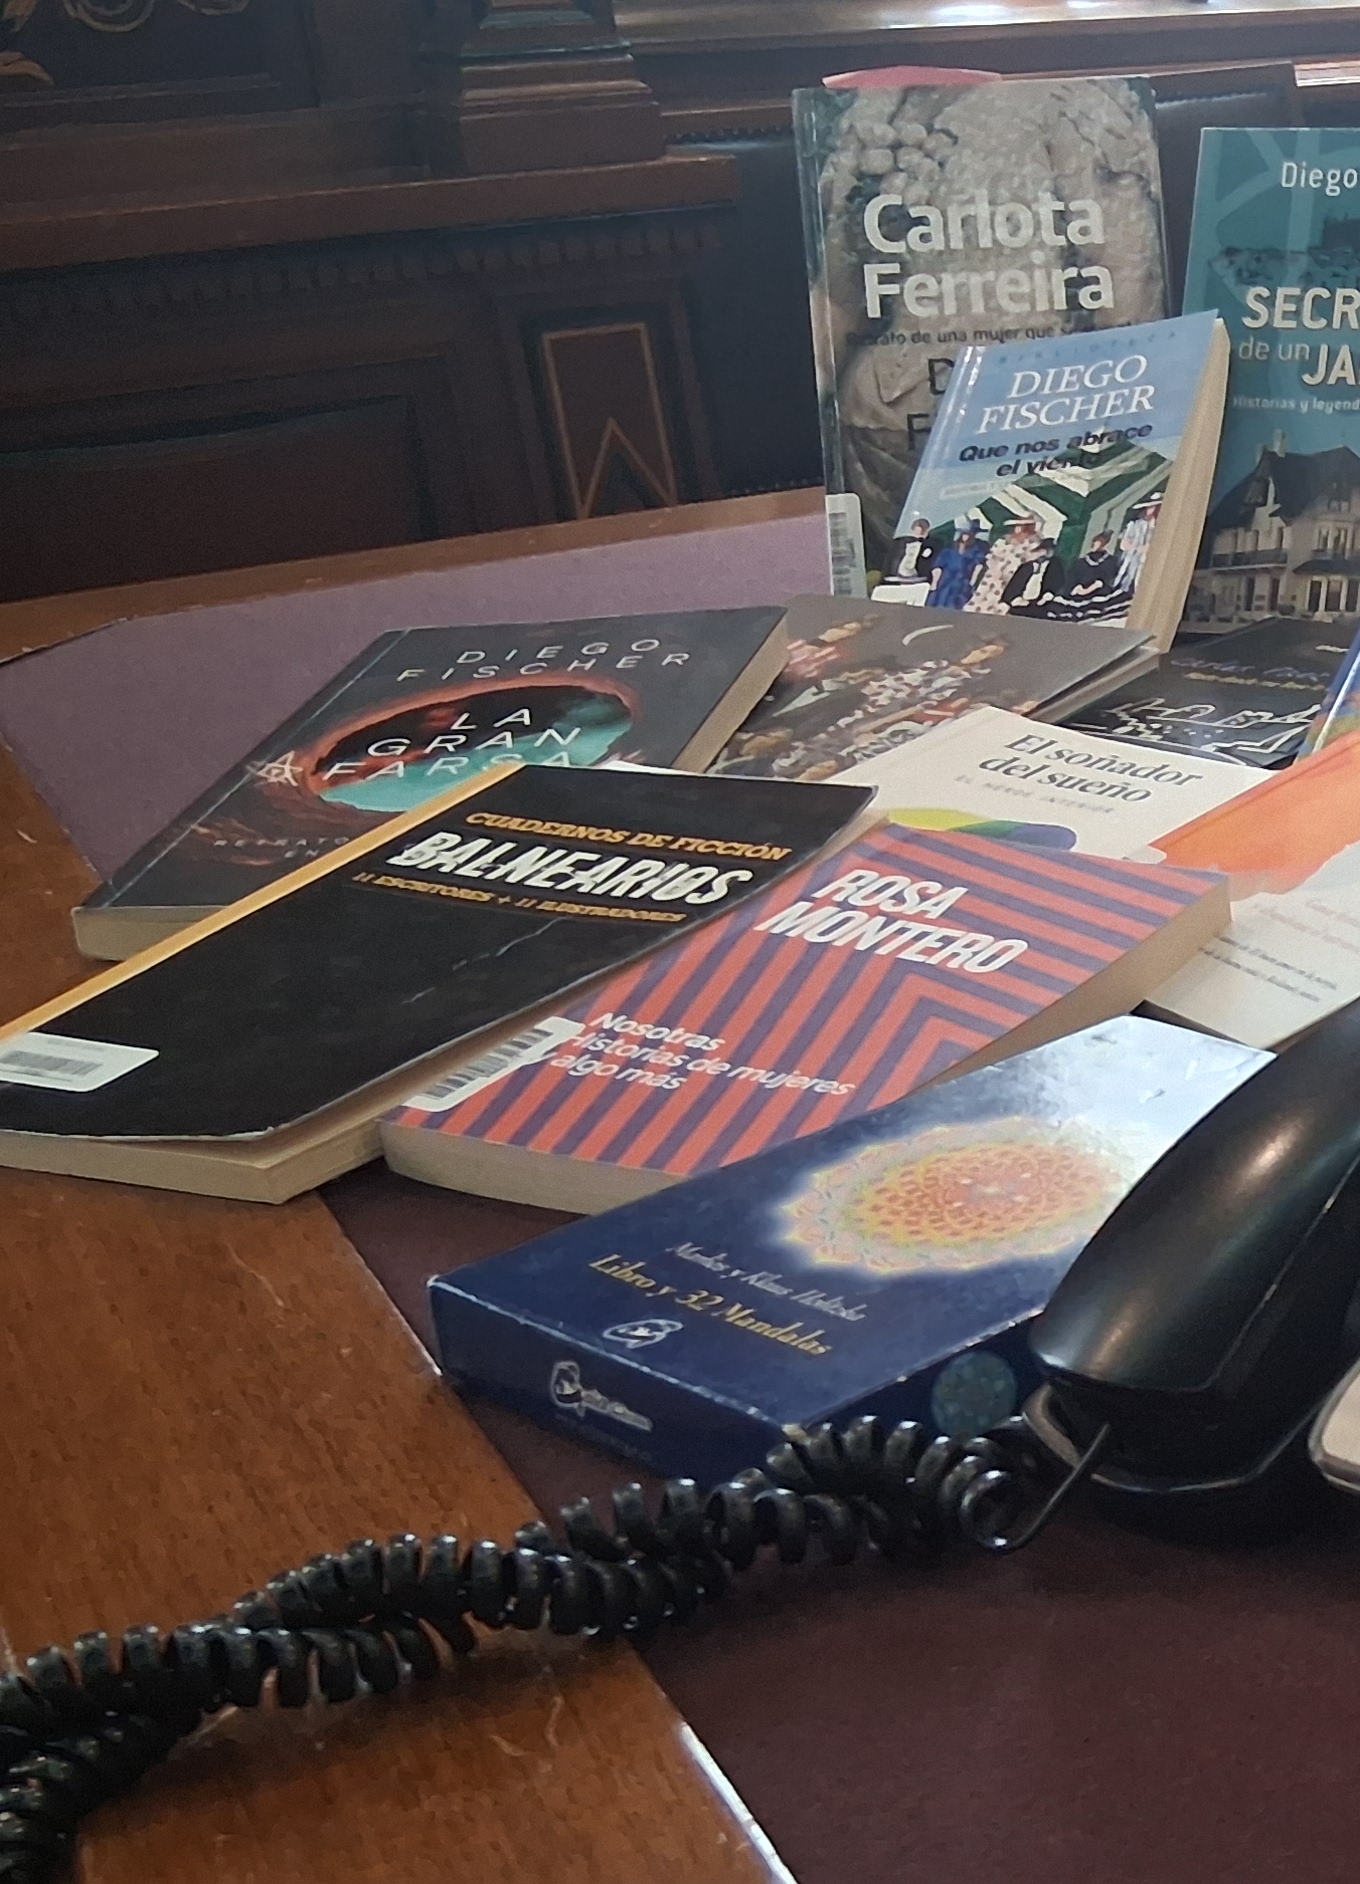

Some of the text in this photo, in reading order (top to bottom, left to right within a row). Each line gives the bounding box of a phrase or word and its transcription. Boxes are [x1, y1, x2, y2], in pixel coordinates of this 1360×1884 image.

[1281, 161, 1358, 197] Diego
[863, 189, 1105, 254] Carlota
[863, 250, 1114, 320] Ferreira
[911, 331, 930, 344] de
[937, 330, 967, 342] una
[973, 327, 1018, 345] mujer
[1025, 325, 1054, 342] que
[1238, 337, 1310, 361] de un
[1007, 354, 1147, 399] DIEGO
[976, 385, 1156, 435] FISCHER
[959, 424, 1153, 462] Que nos abrace
[996, 459, 1021, 477] el
[395, 651, 693, 683] FISCHER
[456, 639, 662, 666] DIEGO
[450, 707, 533, 731] LA
[366, 727, 582, 759] GRAN
[1004, 733, 1203, 788] El soñador
[321, 750, 571, 782] FARSA
[979, 755, 1043, 783] del
[1038, 769, 1153, 804] sueño
[466, 812, 793, 861] CUADERNOS DE FICCIÓN
[386, 831, 754, 905] BALNEARIOS
[813, 870, 970, 919] ROSA
[757, 901, 1029, 974] MONTERO
[589, 1012, 726, 1051] Nosotras
[550, 1053, 688, 1090] algo más
[570, 1031, 856, 1096] Historias de mujeres
[588, 1252, 656, 1289] Libro
[675, 1289, 725, 1312] 32
[711, 1303, 833, 1356] Mandalas
